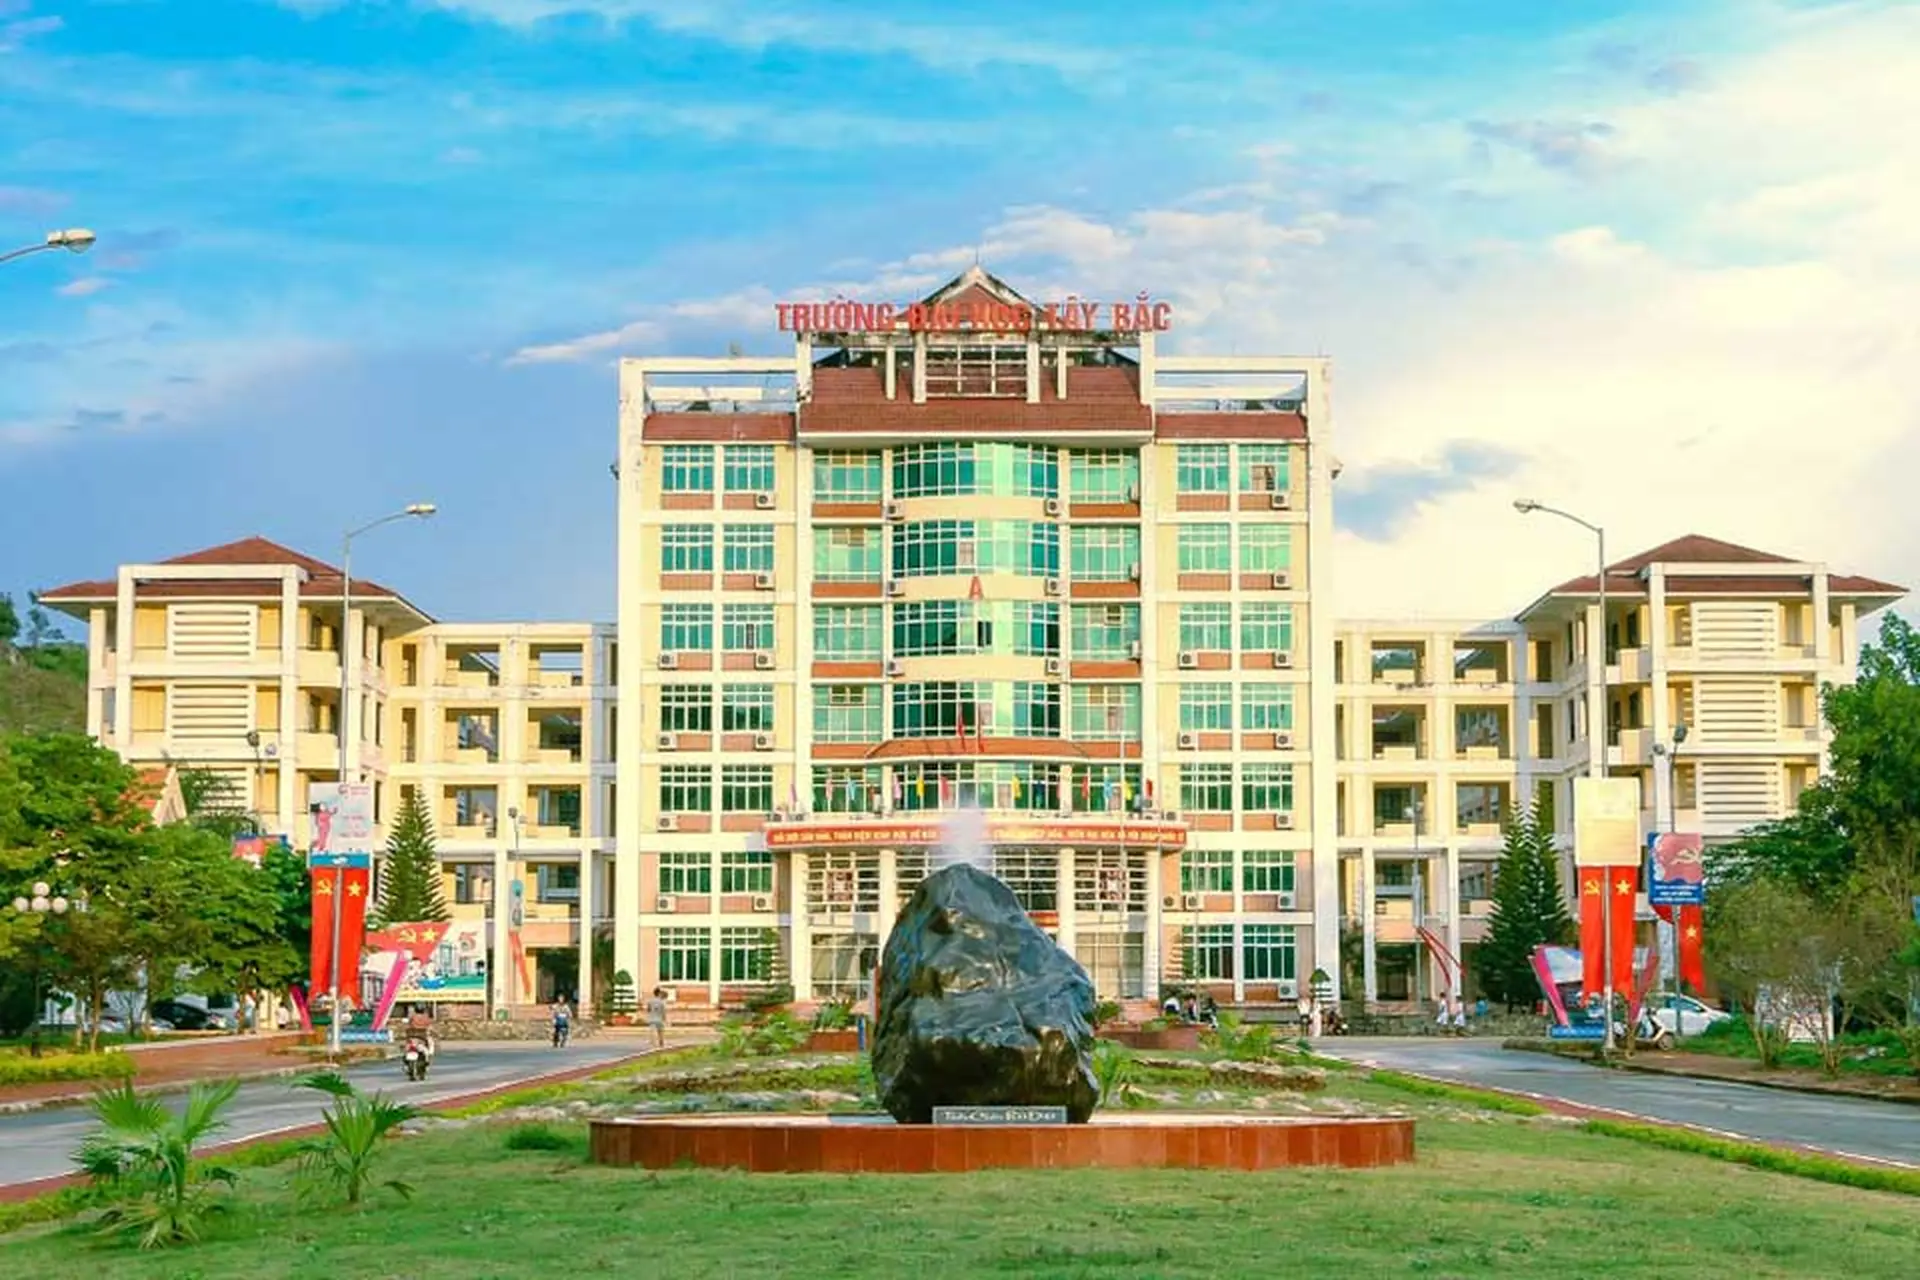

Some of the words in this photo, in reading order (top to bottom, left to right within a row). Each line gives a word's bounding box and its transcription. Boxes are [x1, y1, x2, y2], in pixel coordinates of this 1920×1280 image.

[775, 294, 895, 332] TRƯỜNG
[1043, 295, 1100, 332] TÂY
[1111, 288, 1172, 332] BẮC
[968, 575, 983, 600] A
